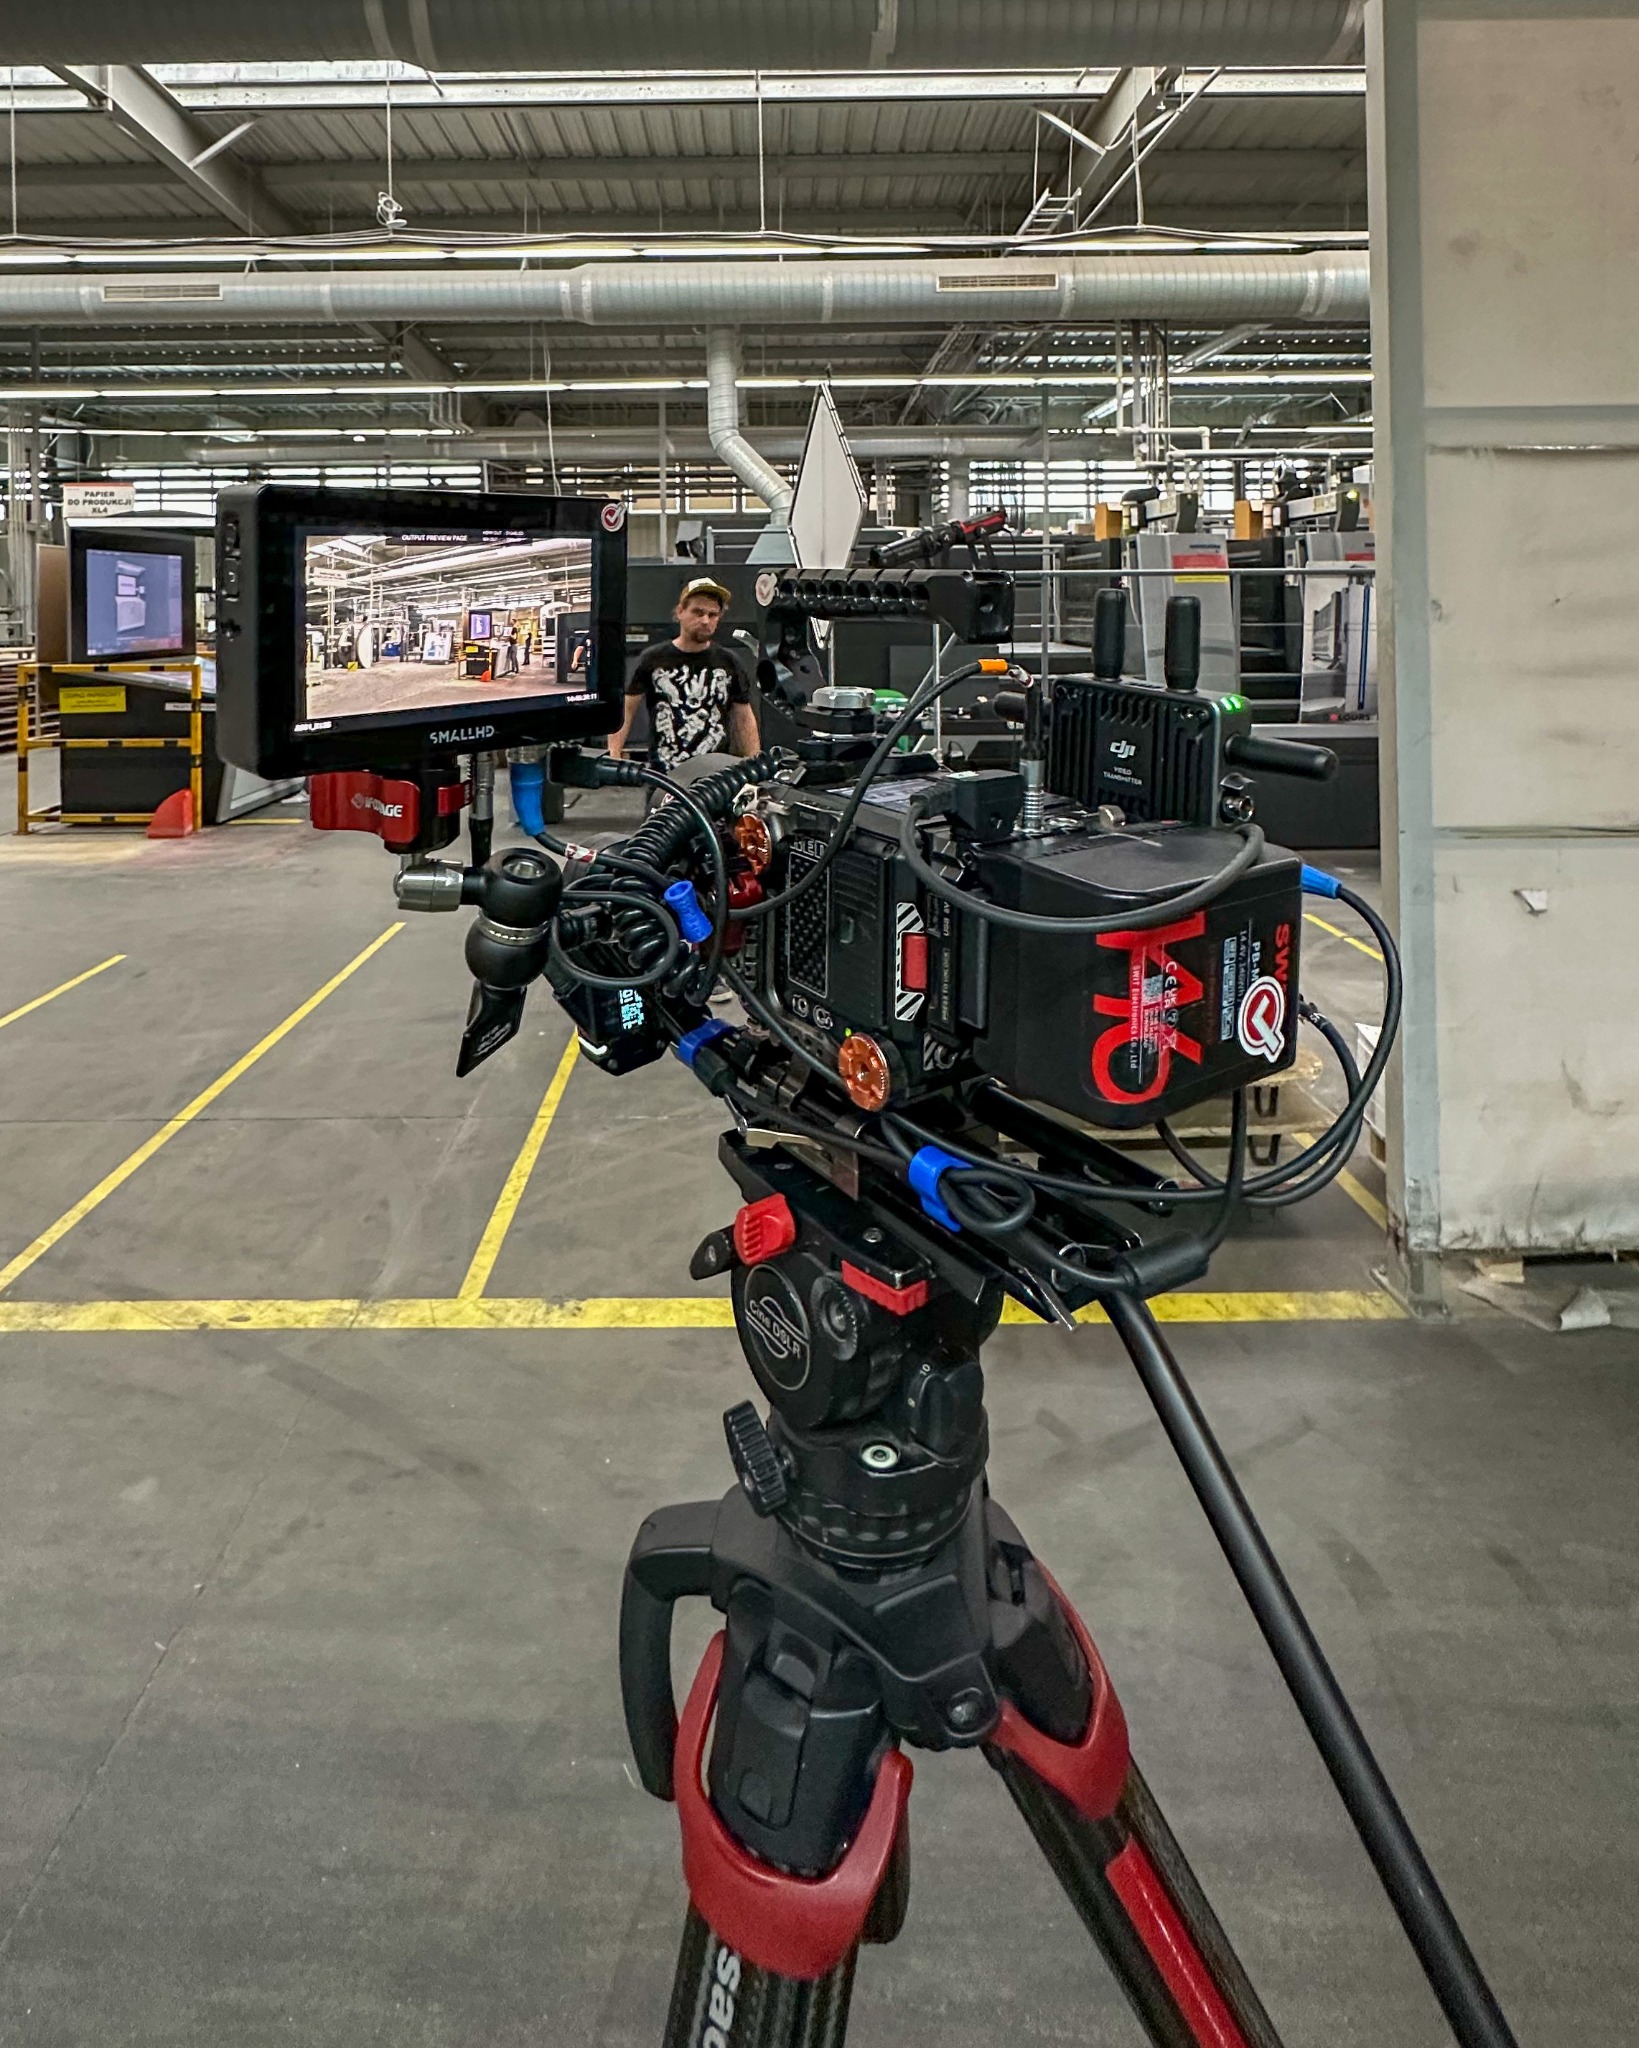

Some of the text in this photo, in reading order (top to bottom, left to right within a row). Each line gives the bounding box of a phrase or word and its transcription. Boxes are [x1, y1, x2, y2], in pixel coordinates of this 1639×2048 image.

[429, 725, 495, 744] SMALLHD
[1103, 770, 1143, 786] TRANSMITTER
[1113, 766, 1132, 776] VIDEO
[1132, 965, 1141, 985] SWIT
[1131, 988, 1140, 1035] Electronics
[750, 1299, 801, 1360] Cine DSLR
